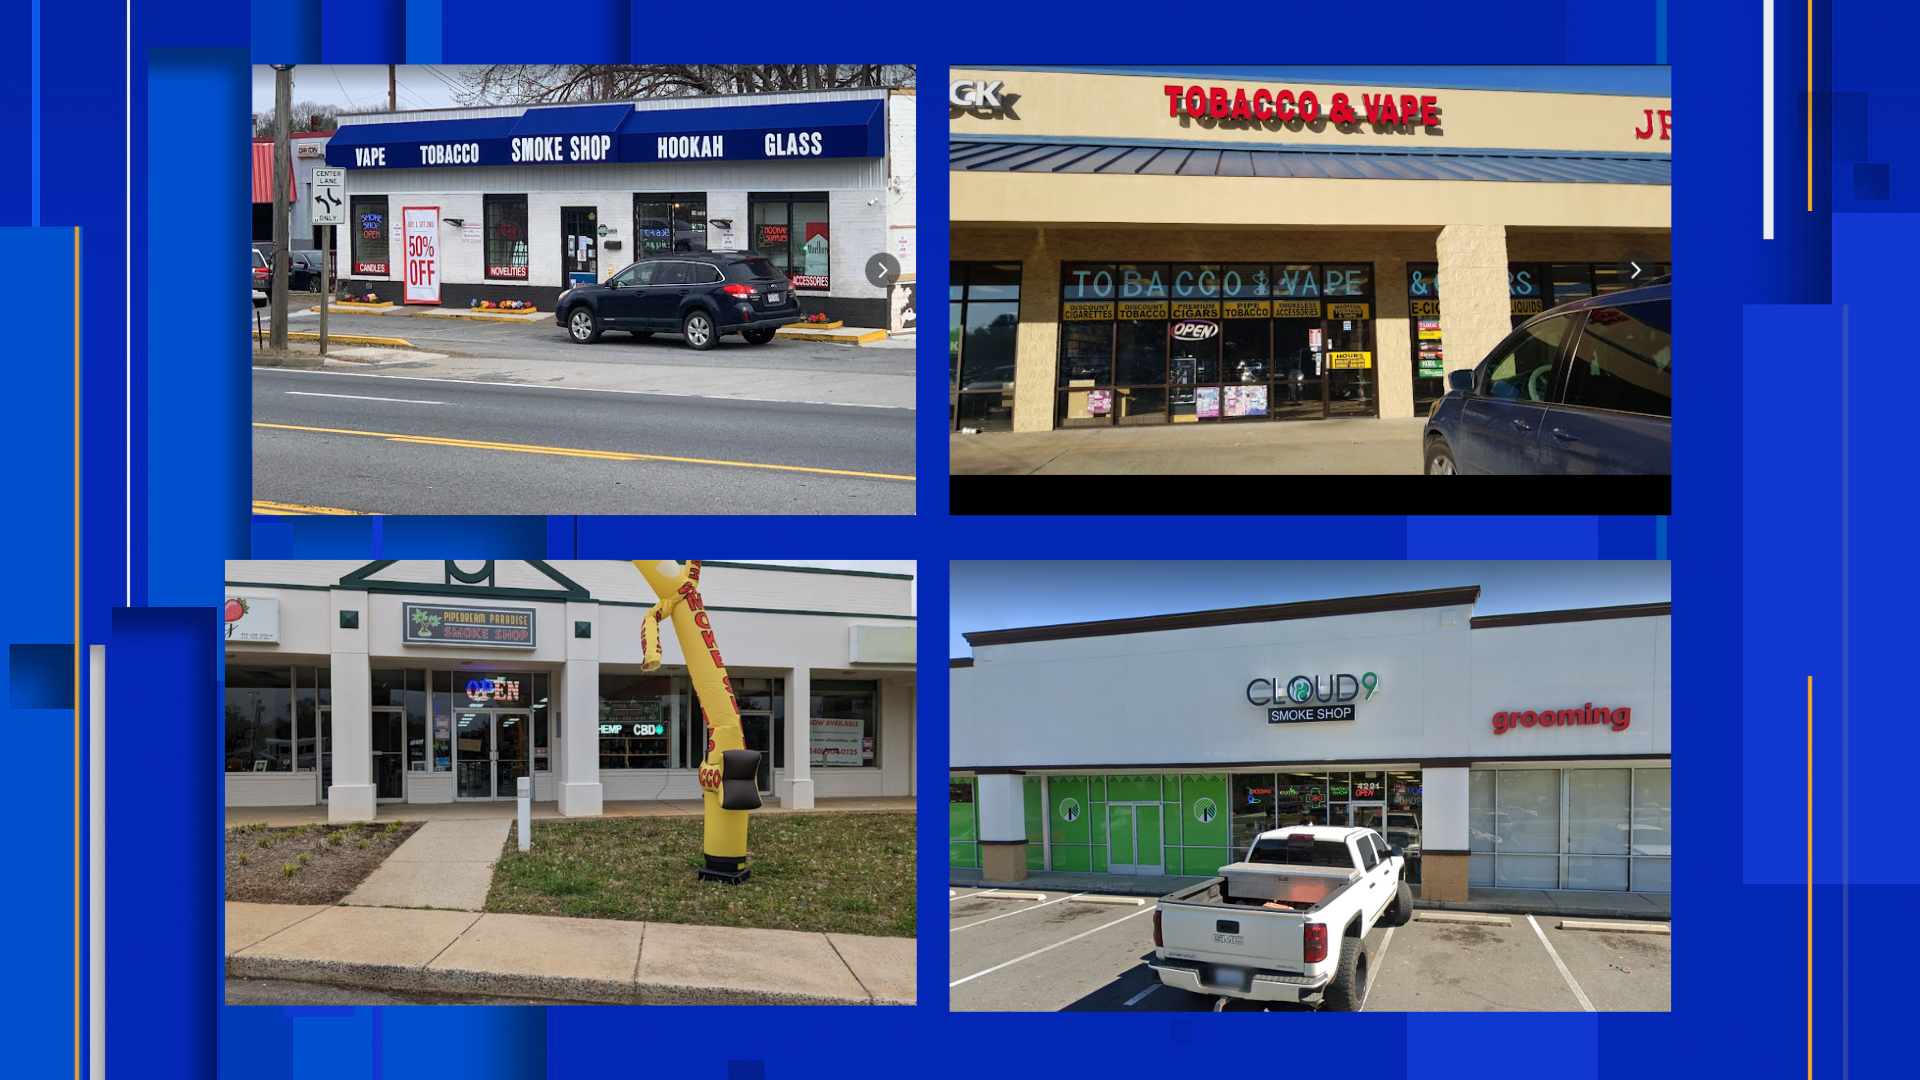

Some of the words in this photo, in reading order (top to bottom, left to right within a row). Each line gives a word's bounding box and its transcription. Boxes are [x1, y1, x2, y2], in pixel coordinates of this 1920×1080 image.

[1164, 84, 1319, 121] TOBACCO
[1329, 92, 1356, 123] &
[1362, 93, 1439, 126] VAPE
[355, 147, 386, 167] VAPE
[420, 143, 480, 165] TOBACCO
[511, 136, 563, 162] SMOKE
[570, 135, 611, 161] SHOP
[657, 135, 724, 159] HOOKAH
[764, 131, 823, 156] GLASS
[361, 213, 382, 222] SMOKE
[363, 221, 379, 230] SHOP
[764, 226, 788, 235] HOOKAH
[363, 230, 381, 239] OPEN
[765, 234, 788, 242] SUPPLIES
[409, 235, 435, 257] 50%
[360, 263, 385, 273] CANDLES
[410, 259, 435, 286] OFF
[793, 275, 829, 287] ACCESSORIES
[1073, 270, 1242, 297] TOBACCO
[1283, 270, 1364, 296] VAPE
[1411, 271, 1428, 295] &
[1064, 310, 1113, 319] CIGARETTES
[1119, 310, 1166, 318] TOBACCO
[1173, 309, 1218, 318] CIGARS
[1225, 308, 1269, 317] TOBACCO
[1275, 308, 1319, 317] ACCESSORIES
[1173, 322, 1214, 338] OPEN
[443, 611, 486, 624] PIPEDREAM
[490, 613, 528, 626] PARADISE
[443, 626, 489, 639] SMOKE
[494, 629, 529, 641] SHOP
[466, 679, 520, 701] OPEN
[1271, 709, 1314, 721] SMOKE
[1317, 707, 1352, 719] SHOP
[1491, 702, 1632, 736] grooming
[633, 723, 656, 736] CBD
[1356, 782, 1380, 790] 4221
[1355, 789, 1375, 797] OPEN
[1213, 933, 1244, 945] GMC
